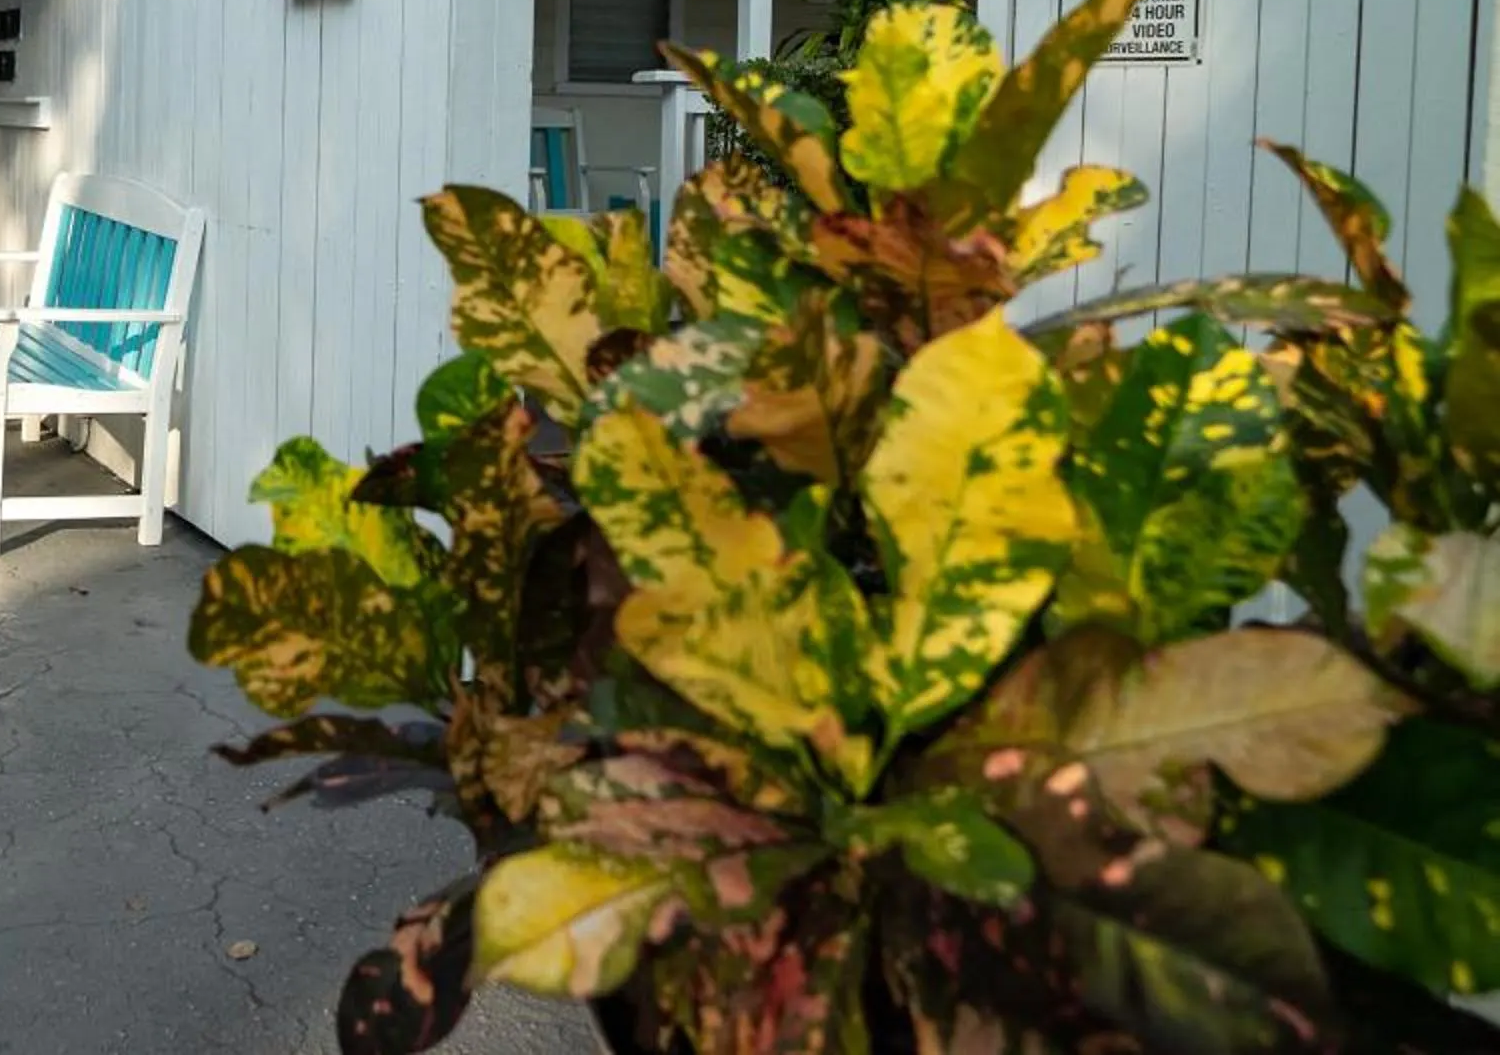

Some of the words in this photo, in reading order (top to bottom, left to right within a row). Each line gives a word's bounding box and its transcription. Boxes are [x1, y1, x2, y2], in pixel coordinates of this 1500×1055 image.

[1145, 4, 1185, 20] HOUR
[1132, 22, 1175, 38] VIDEO
[1107, 40, 1184, 54] RVEILLANCE
